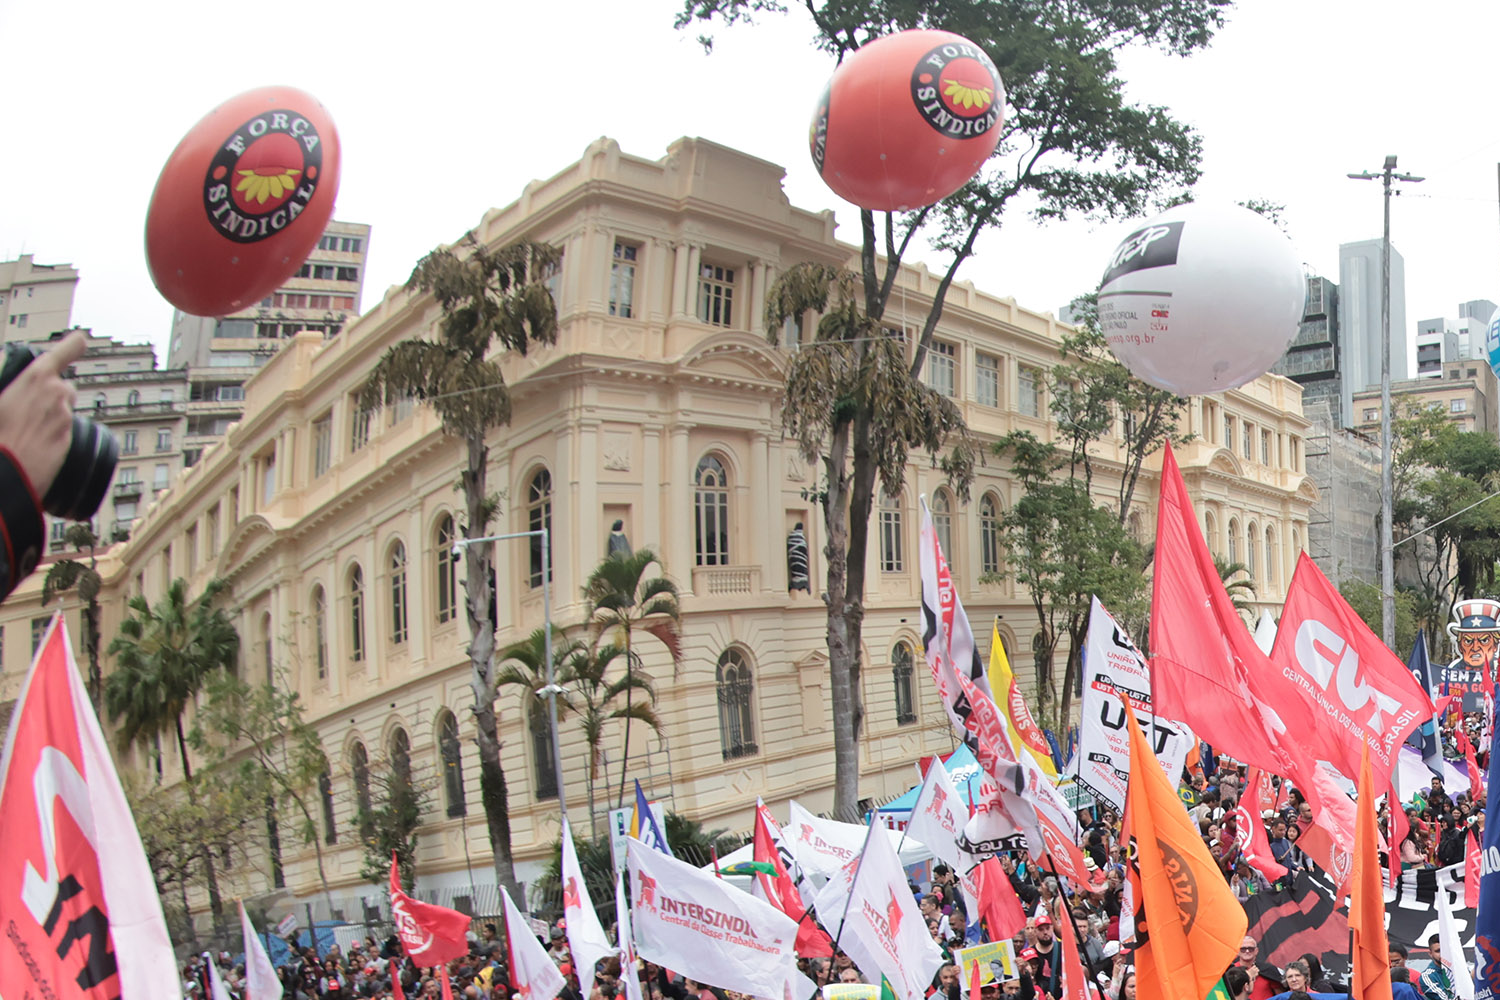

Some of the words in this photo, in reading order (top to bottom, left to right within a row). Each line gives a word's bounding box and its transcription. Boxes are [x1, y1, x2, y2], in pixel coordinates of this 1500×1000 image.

[225, 112, 320, 157] FORÇA
[208, 183, 316, 238] SINDICAL
[1107, 651, 1136, 665] UNIÃO
[1294, 619, 1402, 734] CUT
[1441, 669, 1477, 683] SEM
[1282, 666, 1316, 699] CENTRAL
[1316, 692, 1338, 719] ÚNICA
[660, 912, 690, 930] Central
[691, 919, 700, 931] da
[700, 923, 723, 940] Classe
